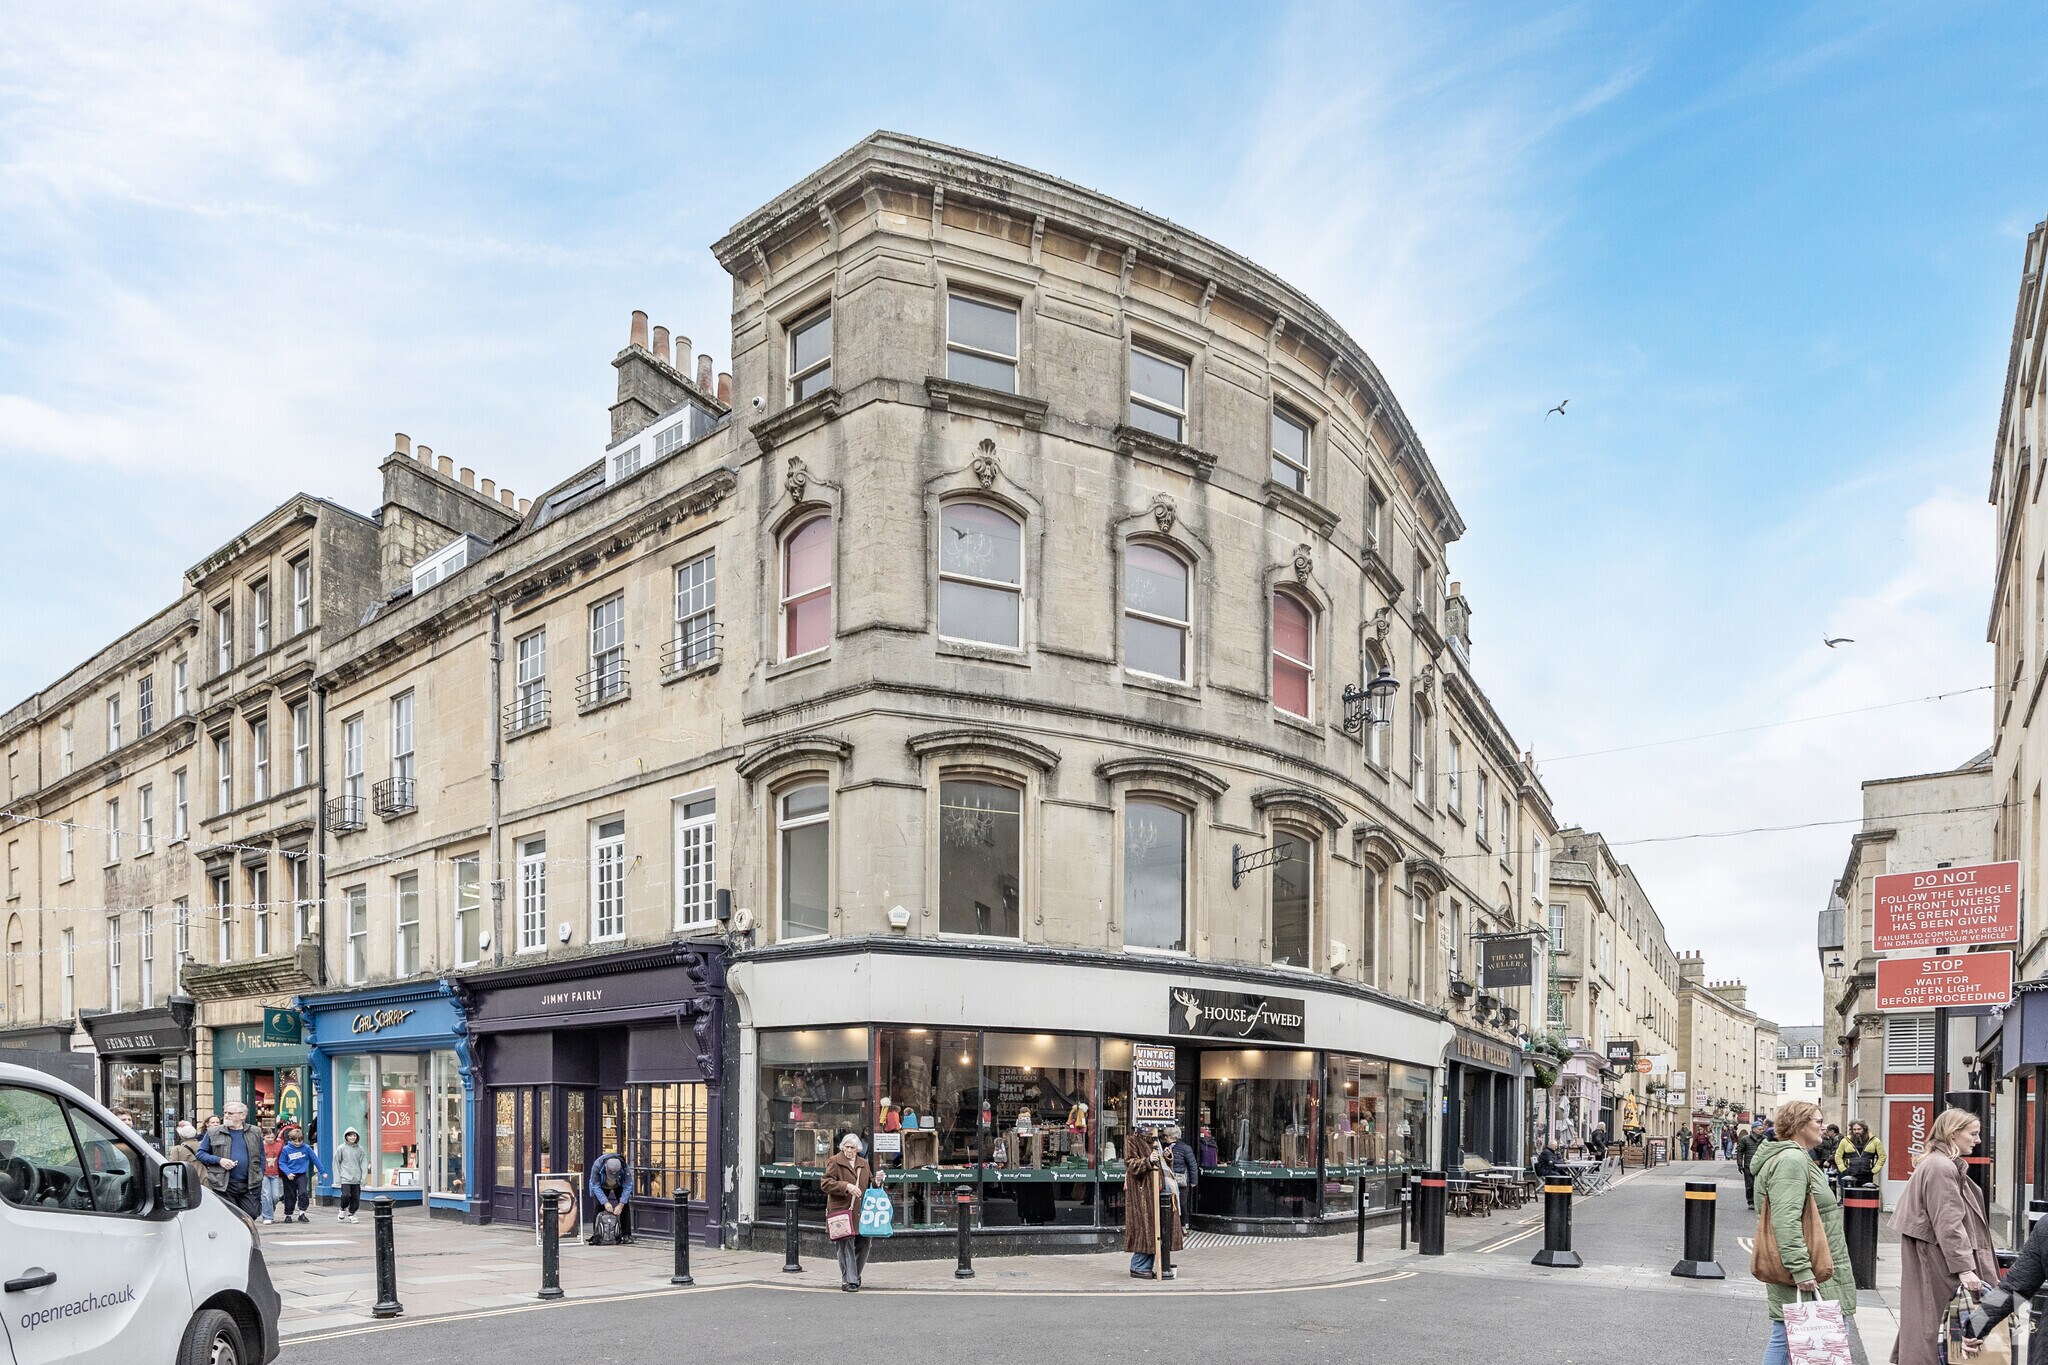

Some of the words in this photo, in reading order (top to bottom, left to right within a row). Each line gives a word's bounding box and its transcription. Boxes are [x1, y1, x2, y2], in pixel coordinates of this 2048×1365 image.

[1914, 875, 1937, 886] DO
[1943, 871, 1977, 884] NOT
[1881, 892, 1927, 904] FOLLOW
[1931, 890, 1954, 900] THE
[1958, 885, 2012, 897] VEHICLE
[1890, 904, 1902, 913] IN
[1908, 900, 1947, 912] FRONT
[1951, 896, 2001, 908] UNLESS
[1890, 912, 1913, 922] THE
[1917, 908, 1958, 920] GREEN
[1964, 905, 2000, 916] LIGHT
[1892, 920, 1916, 931] HAS
[1921, 917, 1954, 929] BEEN
[1958, 914, 1997, 926] GIVEN
[1878, 934, 1910, 942] FAILURE
[1926, 930, 1958, 938] COMPLY
[1896, 938, 1930, 947] DAMAGE
[1970, 932, 2006, 940] VEHICLE
[1488, 960, 1528, 970] WELLER'S
[1922, 959, 1964, 972] STOP
[1916, 978, 1943, 986] WAIT
[1946, 976, 1969, 984] FOR
[1904, 986, 1943, 996] GREEN
[1947, 984, 1981, 993] LIGHT
[542, 992, 568, 1005] JIMMY
[572, 990, 602, 1002] FAIRLY
[1882, 996, 1924, 1006] BEFORE
[1928, 992, 2006, 1003] PROCEEDING
[1204, 1006, 1246, 1022] HOUSE
[1239, 1002, 1267, 1036] of
[1262, 1012, 1302, 1027] TWEED
[105, 1036, 134, 1050] FRENCH
[135, 1034, 156, 1047] GREY
[248, 1035, 261, 1048] THE
[1456, 1036, 1470, 1056] THE
[1138, 1050, 1174, 1060] VINTAGE
[1138, 1059, 1175, 1069] CLOTHING
[1137, 1072, 1162, 1084] THIS
[1137, 1084, 1162, 1096] WAY!
[1138, 1100, 1174, 1108] FIREFLY
[1138, 1108, 1174, 1117] VINTAGE
[21, 1284, 136, 1331] openreach.co.uk
